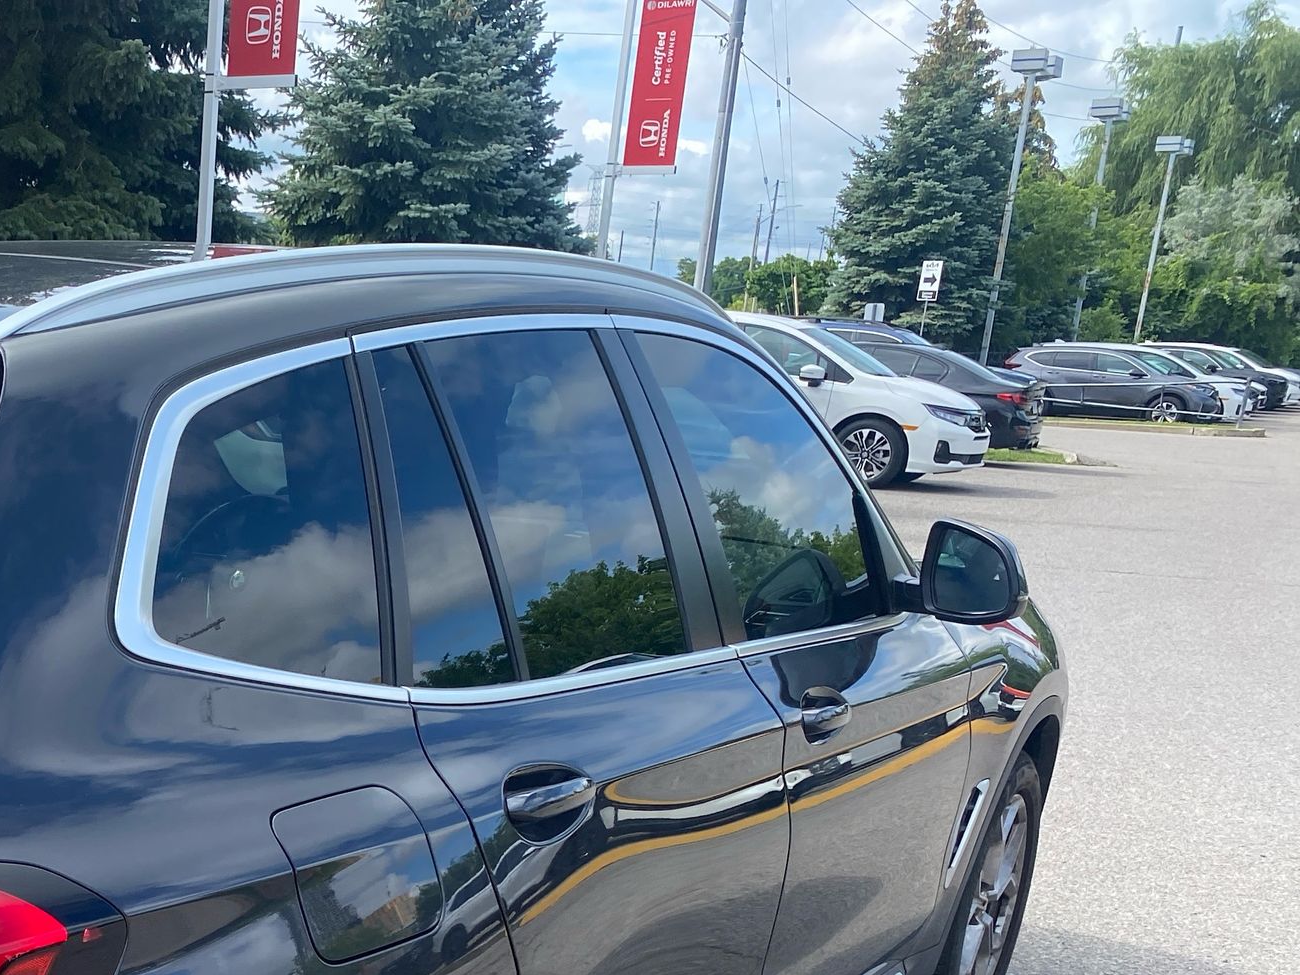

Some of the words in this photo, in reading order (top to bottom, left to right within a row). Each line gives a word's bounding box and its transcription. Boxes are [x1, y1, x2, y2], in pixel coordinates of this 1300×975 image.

[272, 0, 284, 59] HOND
[657, 0, 695, 9] DILAWRI
[651, 31, 667, 86] Certified
[663, 30, 677, 85] PRE-OWNED
[658, 109, 671, 158] HONDA
